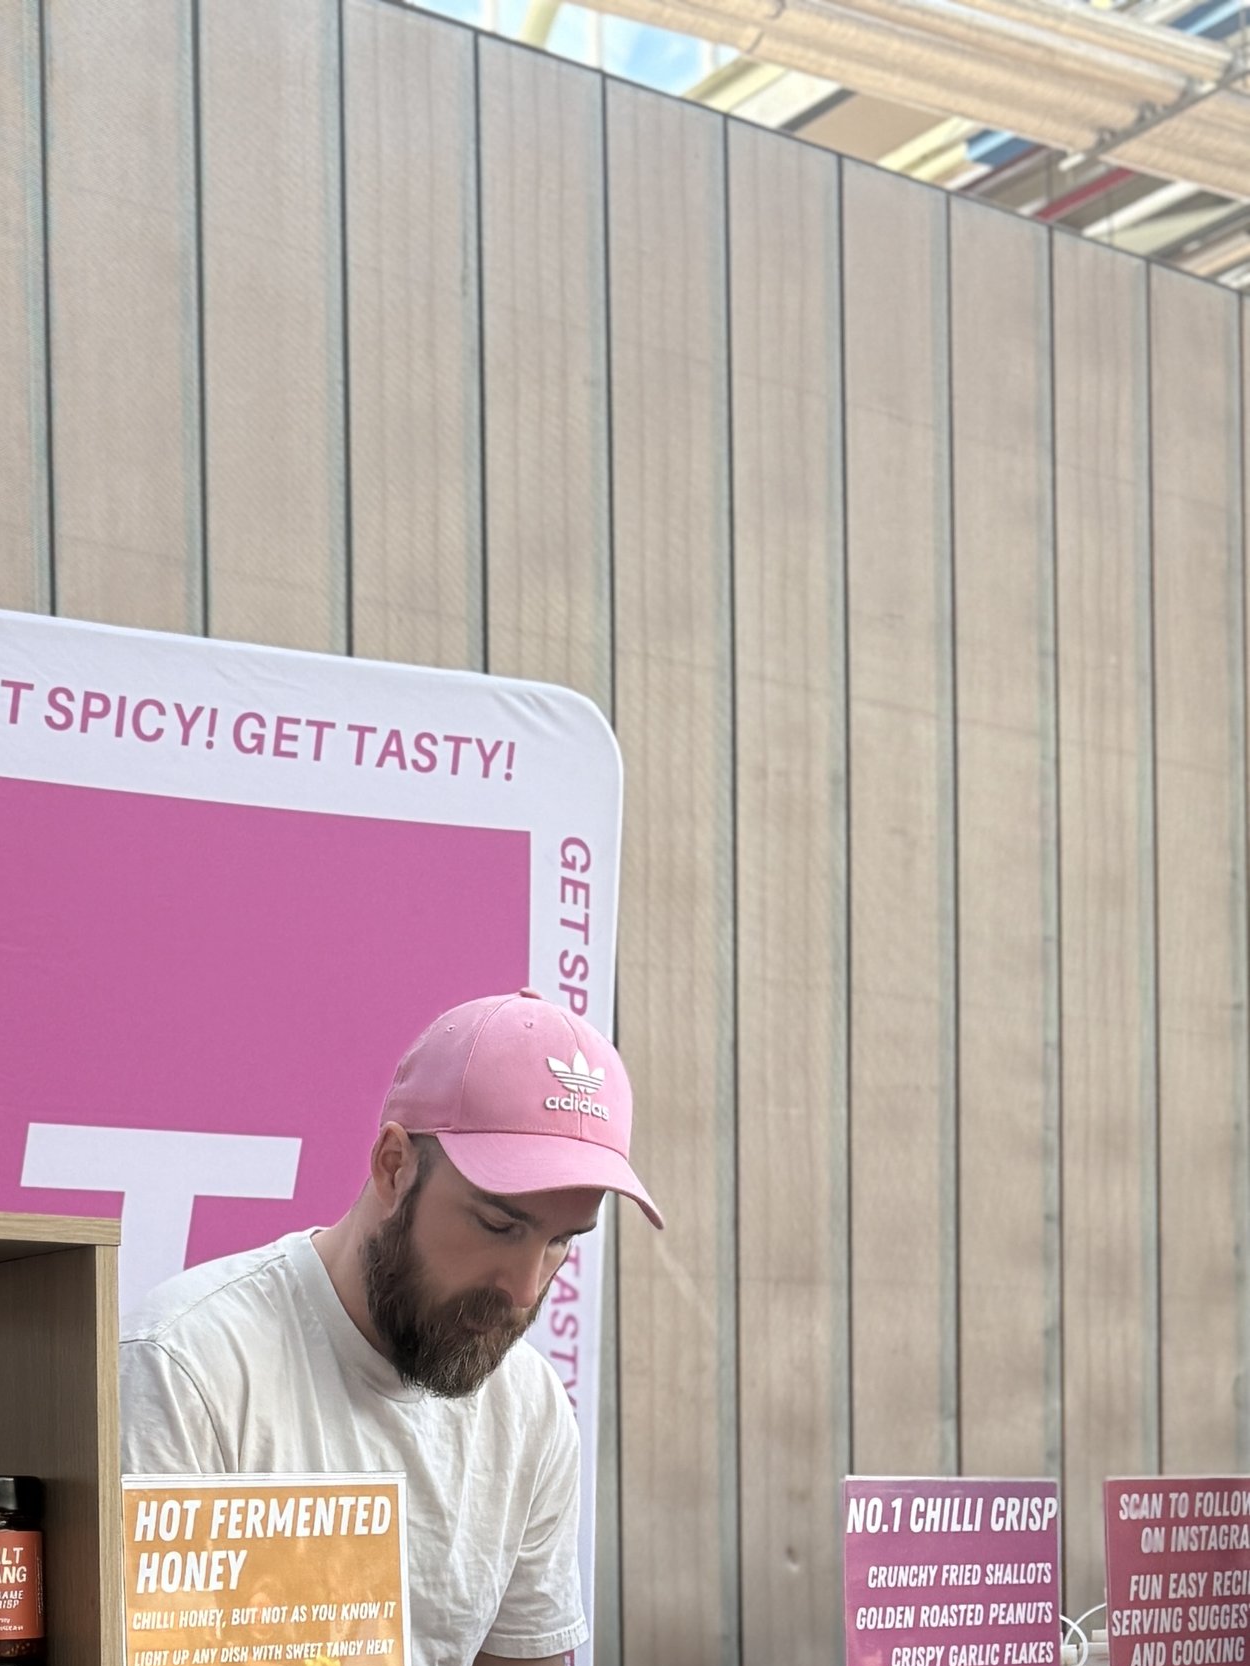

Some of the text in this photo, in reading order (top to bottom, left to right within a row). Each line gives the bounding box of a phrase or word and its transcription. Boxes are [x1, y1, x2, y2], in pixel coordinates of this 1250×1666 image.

[43, 686, 218, 749] SPICY!
[232, 711, 336, 761] GET
[347, 725, 516, 781] TASTY!
[559, 836, 592, 945] GET
[544, 1093, 610, 1122] adidas
[134, 1496, 391, 1542] HOT FERMENTED
[847, 1497, 1058, 1534] NO.1 CHILLI CRISP
[1119, 1493, 1163, 1520] SCAN
[1169, 1492, 1189, 1518] TO
[1141, 1527, 1165, 1553] ON
[136, 1550, 247, 1594] HONEY
[868, 1562, 1052, 1588] CRUNCHY FRIED SHALLOTS
[1130, 1575, 1163, 1601] FUN
[1169, 1572, 1208, 1599] EASY
[132, 1601, 396, 1631] CHILLI HONEY, BUT NOT AS YOU KNOW IT
[856, 1602, 1053, 1630] GOLDEN ROASTED PEANUTS
[1112, 1603, 1250, 1637] SERVING SUGGES
[173, 1650, 189, 1666] UP
[193, 1648, 217, 1664] ANY
[220, 1646, 248, 1663] DISH
[252, 1644, 282, 1661] WITH
[285, 1643, 323, 1659] SWEET
[326, 1641, 363, 1658] TANGY
[366, 1639, 394, 1656] HEAT
[1004, 1641, 1054, 1666] FLAKES
[1172, 1636, 1245, 1666] COOKING
